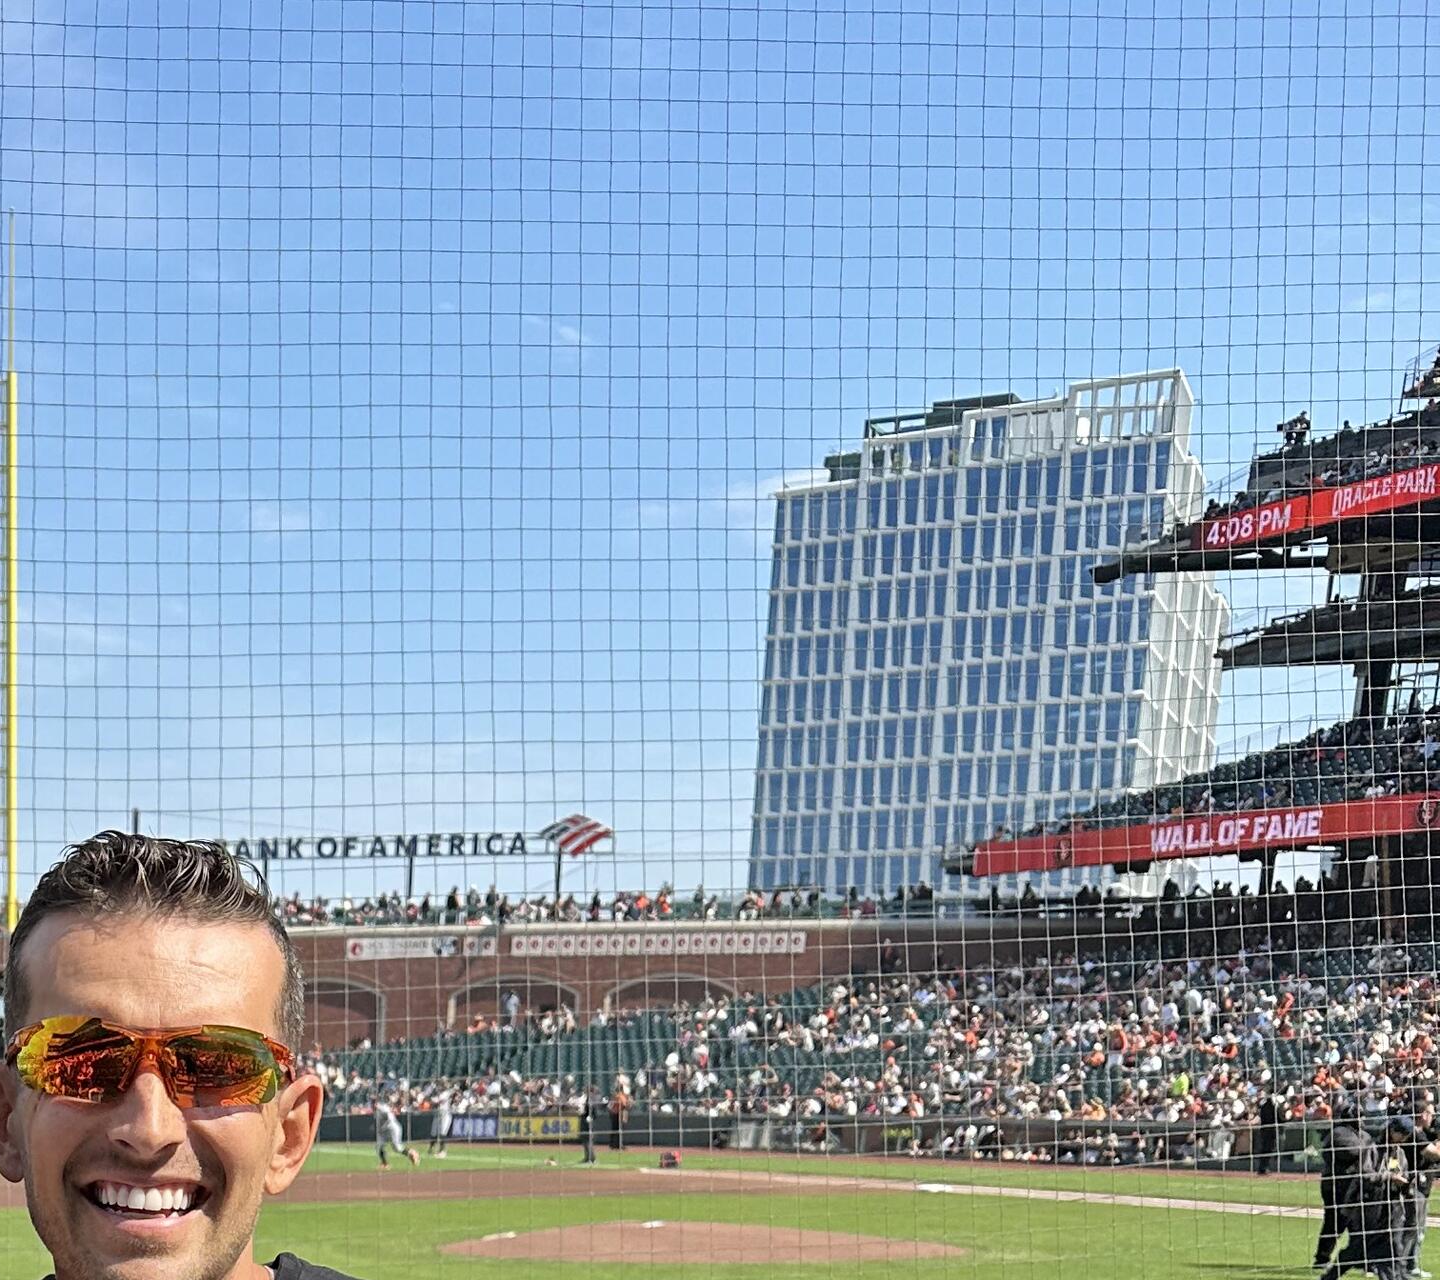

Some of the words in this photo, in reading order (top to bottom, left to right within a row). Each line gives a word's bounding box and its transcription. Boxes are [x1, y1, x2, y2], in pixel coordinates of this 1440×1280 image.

[1331, 478, 1392, 517] ORACLE
[1395, 465, 1439, 495] PARK
[1206, 513, 1253, 545] 4:08
[1259, 503, 1292, 534] PM
[216, 838, 304, 859] ANK
[317, 837, 357, 859] OF
[369, 832, 528, 858] AMERICA
[1150, 822, 1214, 852] WALL
[1217, 816, 1251, 846] OF
[1251, 810, 1324, 843] FAME
